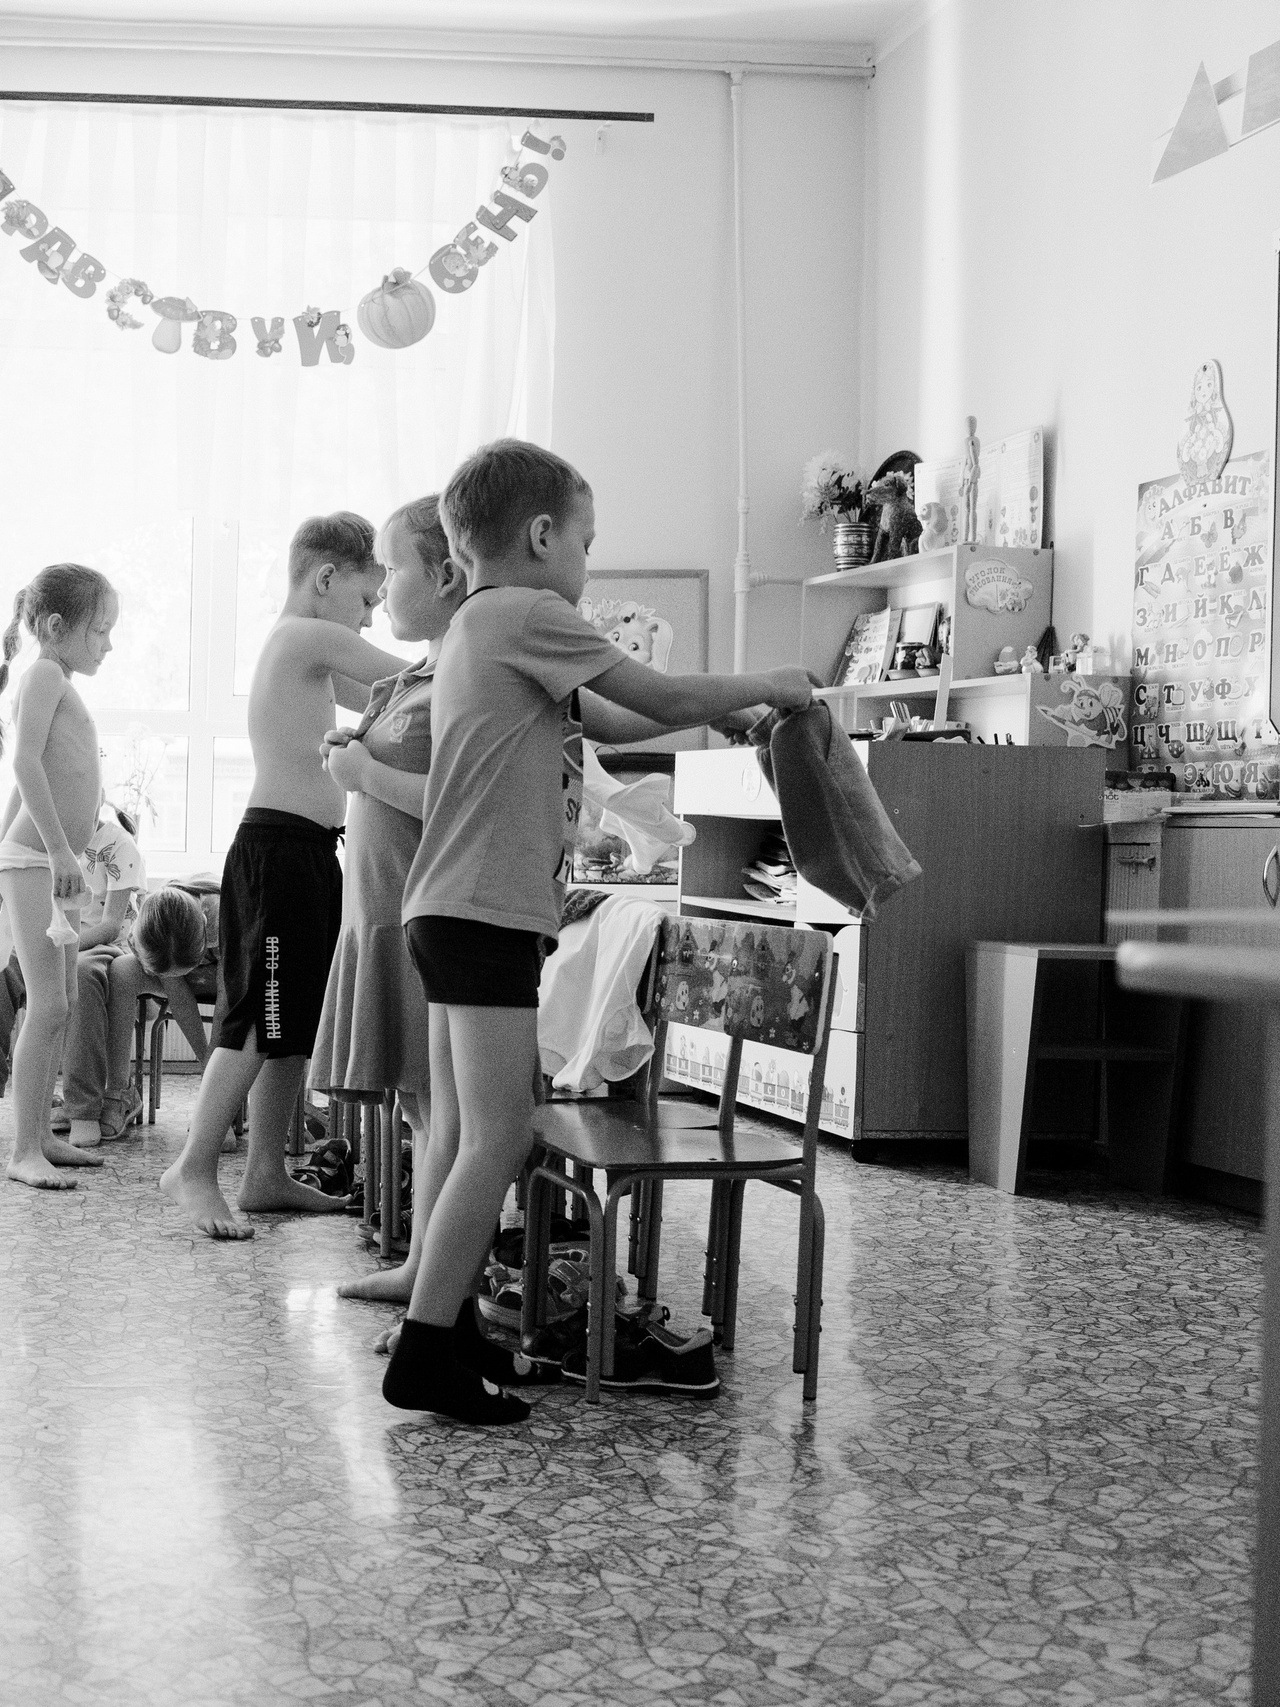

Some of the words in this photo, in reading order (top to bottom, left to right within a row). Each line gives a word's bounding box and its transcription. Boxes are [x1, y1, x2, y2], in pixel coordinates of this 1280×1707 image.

[1158, 475, 1251, 518] АЛФАВИТ
[1190, 516, 1202, 536] Б
[1223, 508, 1234, 529] В
[969, 567, 1006, 584] УГОЛОК
[1139, 567, 1149, 586] Г
[1161, 563, 1175, 585] Д
[1194, 556, 1206, 576] Е
[1219, 546, 1231, 572] Ё
[1243, 545, 1265, 567] Ж
[1164, 603, 1177, 623] И
[1193, 594, 1208, 619] Й
[1219, 594, 1233, 615] К
[1135, 647, 1150, 667] М
[1164, 644, 1178, 664] Н
[1215, 637, 1231, 657] П
[1163, 684, 1175, 704] Т
[1189, 681, 1203, 702] У
[1215, 678, 1232, 700] Ф
[1133, 726, 1146, 746] Ц
[1158, 725, 1170, 743] Ч
[1186, 722, 1204, 742] Ш
[1217, 720, 1238, 743] Щ
[1184, 763, 1197, 785] Э
[1214, 763, 1233, 784] Ю
[1245, 763, 1258, 784] Я
[265, 936, 279, 970] CLUB
[265, 980, 281, 1039] RUNNING
